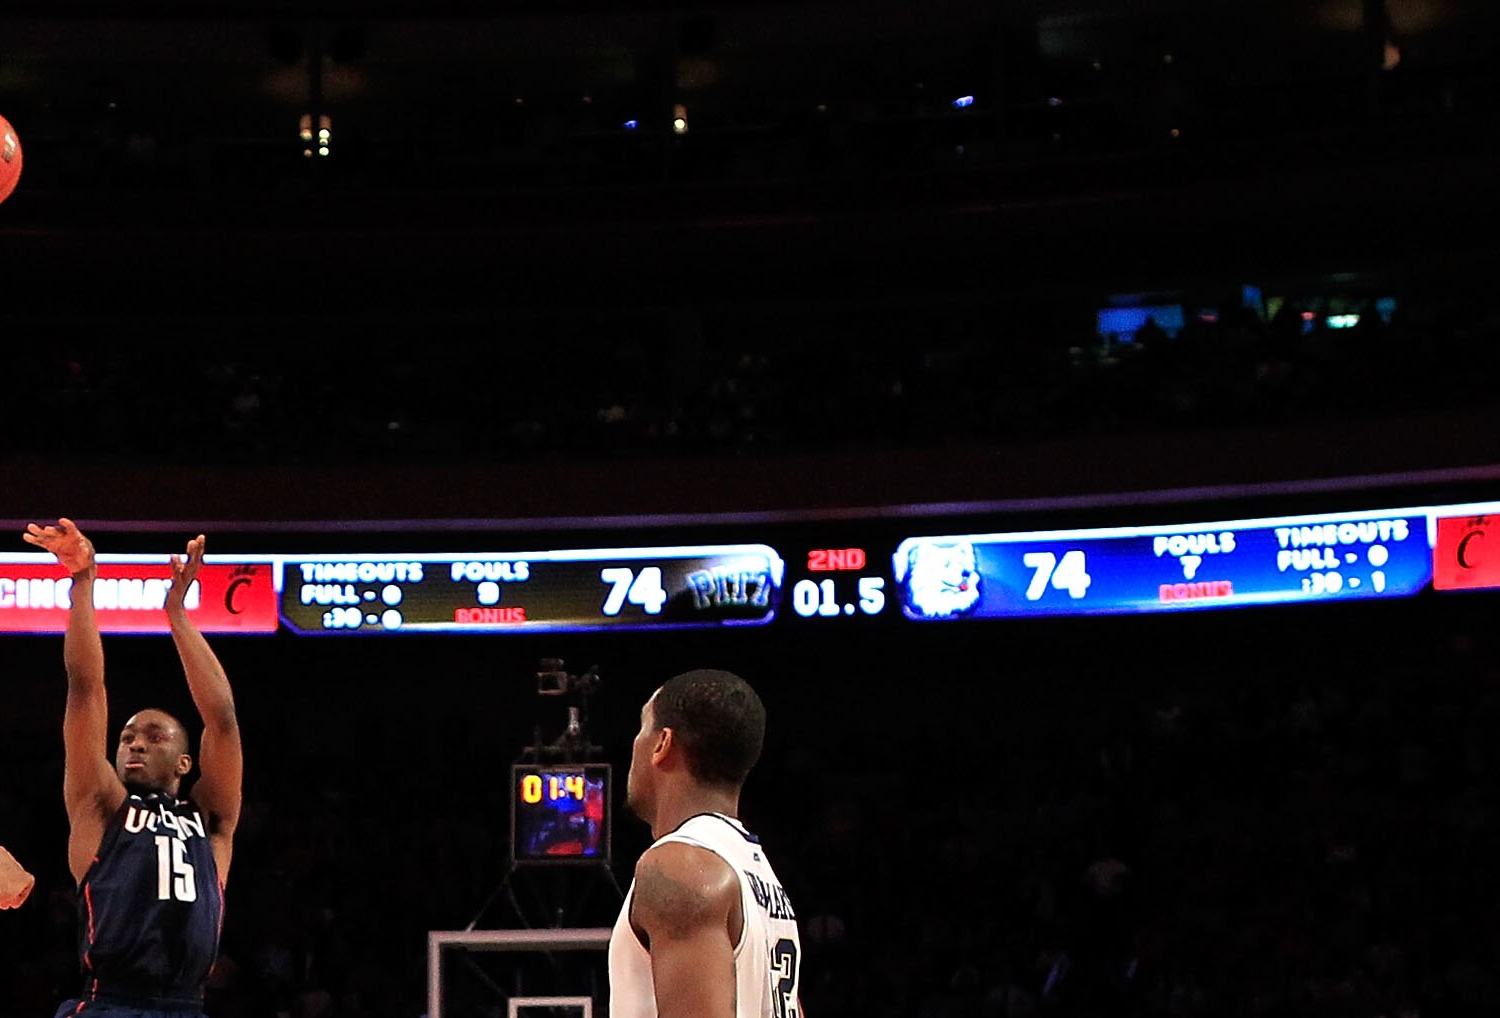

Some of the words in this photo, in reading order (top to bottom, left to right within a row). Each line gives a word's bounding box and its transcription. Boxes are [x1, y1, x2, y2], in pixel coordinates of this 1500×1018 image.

[1153, 532, 1236, 557] FOULS
[1275, 519, 1409, 548] TIMEOUTS
[451, 561, 529, 582] FOULS
[807, 548, 866, 571] 2ND
[1180, 555, 1202, 580] 7
[1277, 547, 1340, 572] FULL
[300, 562, 423, 583] TIMEOUTS
[1023, 550, 1091, 601] 74
[301, 584, 360, 605] FULL
[601, 567, 666, 616] 74
[793, 576, 885, 617] 01.5
[1159, 581, 1233, 604] BONUS
[455, 608, 527, 624] BONUS
[155, 835, 197, 902] 15
